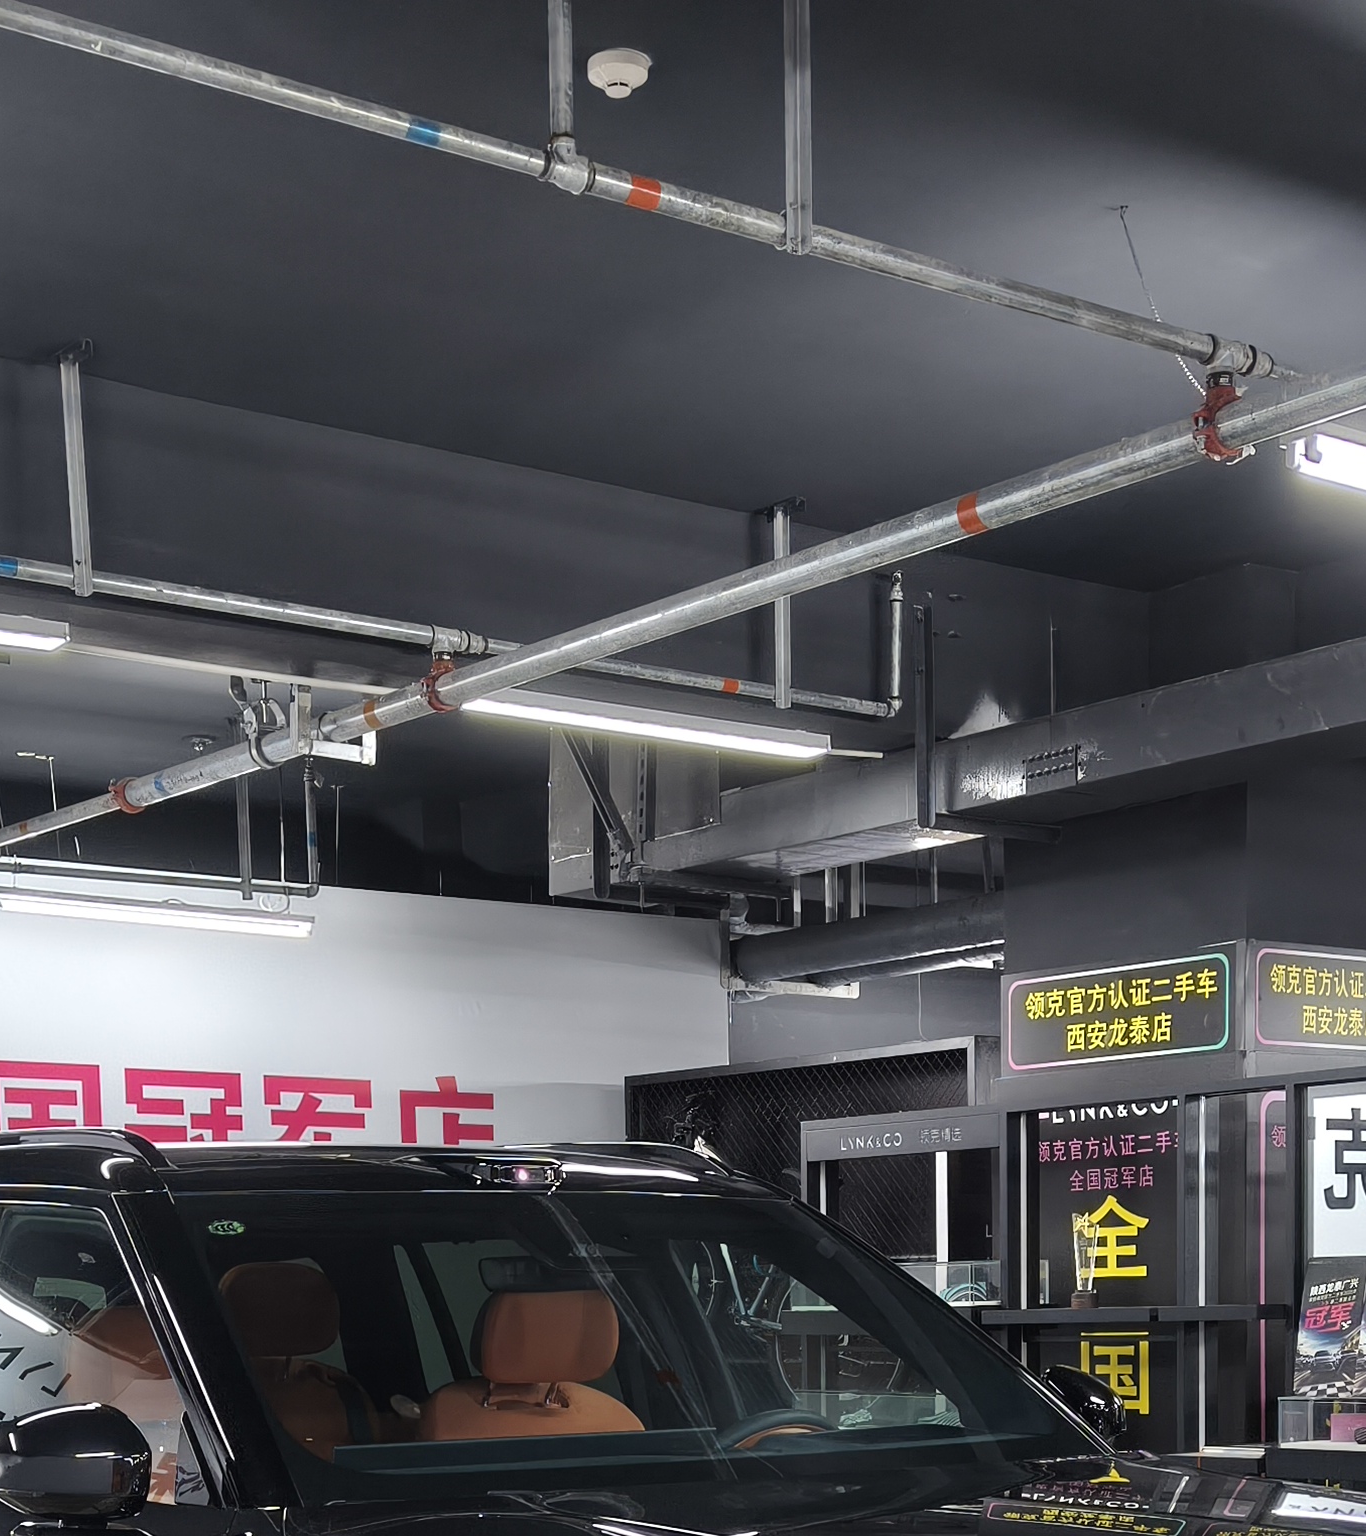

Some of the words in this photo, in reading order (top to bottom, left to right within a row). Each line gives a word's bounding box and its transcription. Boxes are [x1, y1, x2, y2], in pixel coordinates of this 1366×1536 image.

[1024, 968, 1219, 1021] 领克官方认证二手车
[1065, 1011, 1173, 1052] 西安龙泰店
[840, 1132, 903, 1151] LYNK&CO
[1069, 1164, 1154, 1192] 全国冠军店
[1304, 1301, 1356, 1333] 冠军
